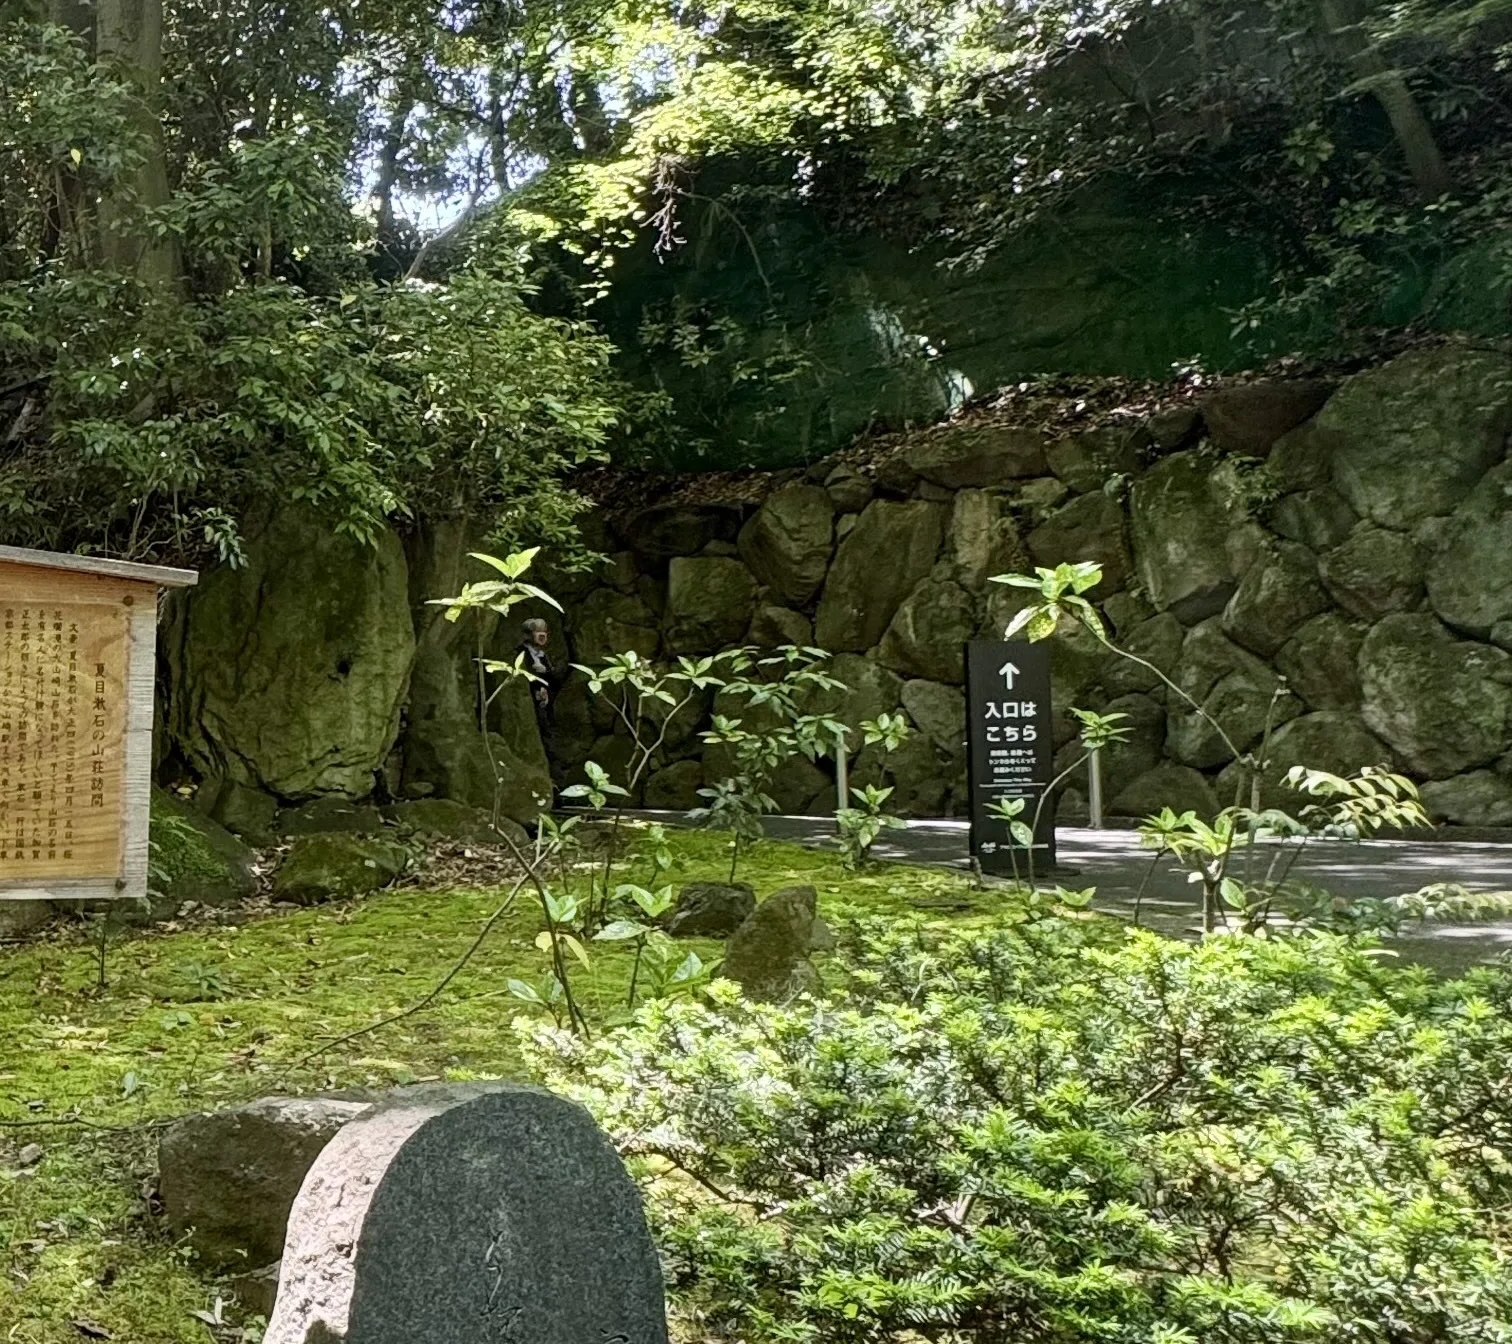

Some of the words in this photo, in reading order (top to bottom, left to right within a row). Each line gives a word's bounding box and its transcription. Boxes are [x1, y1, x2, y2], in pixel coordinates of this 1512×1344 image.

[985, 701, 1037, 719] 入口は
[91, 663, 107, 808] 夏目漱石の山荘訪問
[986, 725, 1037, 742] こちら
